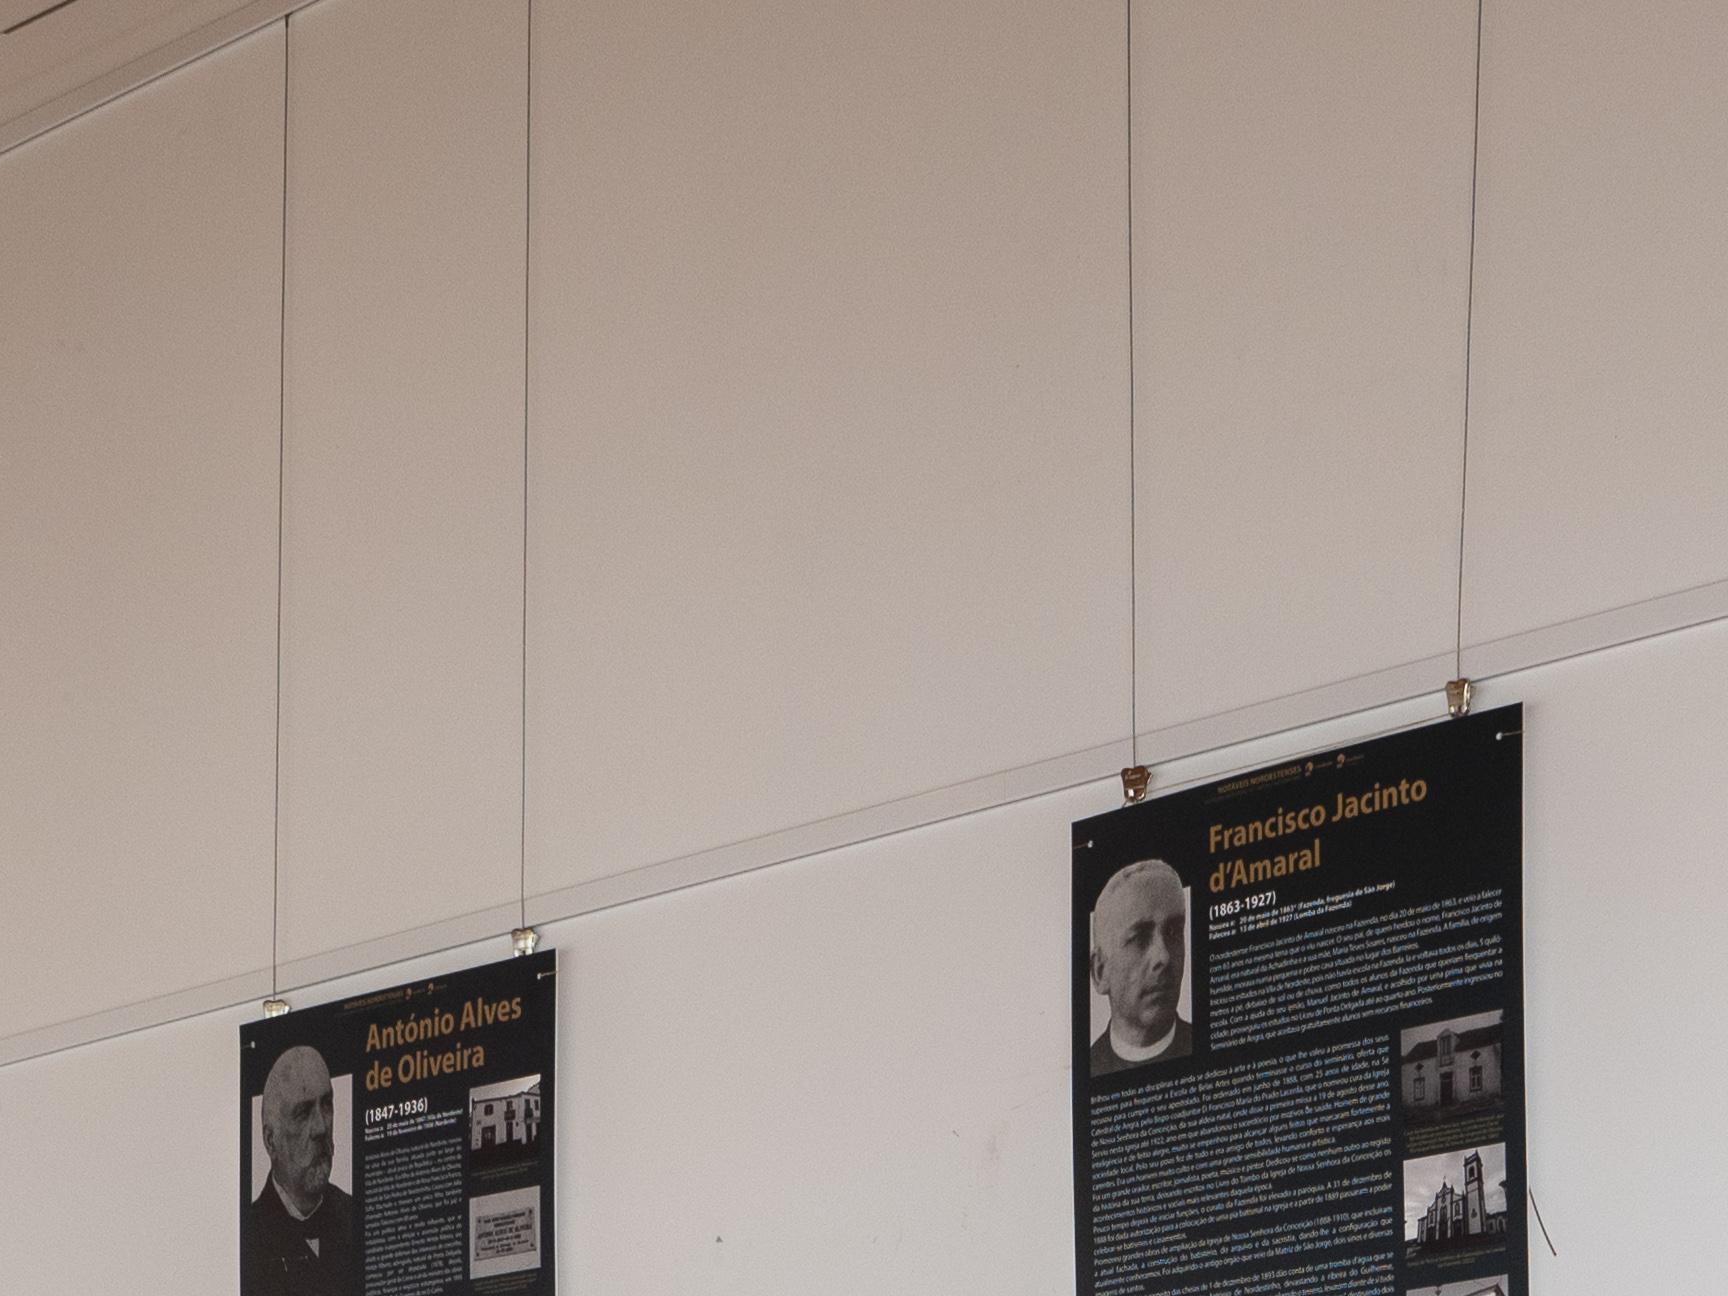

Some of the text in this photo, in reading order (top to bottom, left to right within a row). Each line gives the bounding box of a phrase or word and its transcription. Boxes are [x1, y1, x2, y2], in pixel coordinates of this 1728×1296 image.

[1209, 778, 1427, 853] Francisco Jacinto
[1209, 837, 1320, 893] d'Amaral
[1208, 890, 1276, 920] (1863-1927)
[365, 996, 521, 1052] António Alves
[365, 1041, 484, 1091] de Oliveira
[365, 1096, 428, 1125] (1847-1936)
